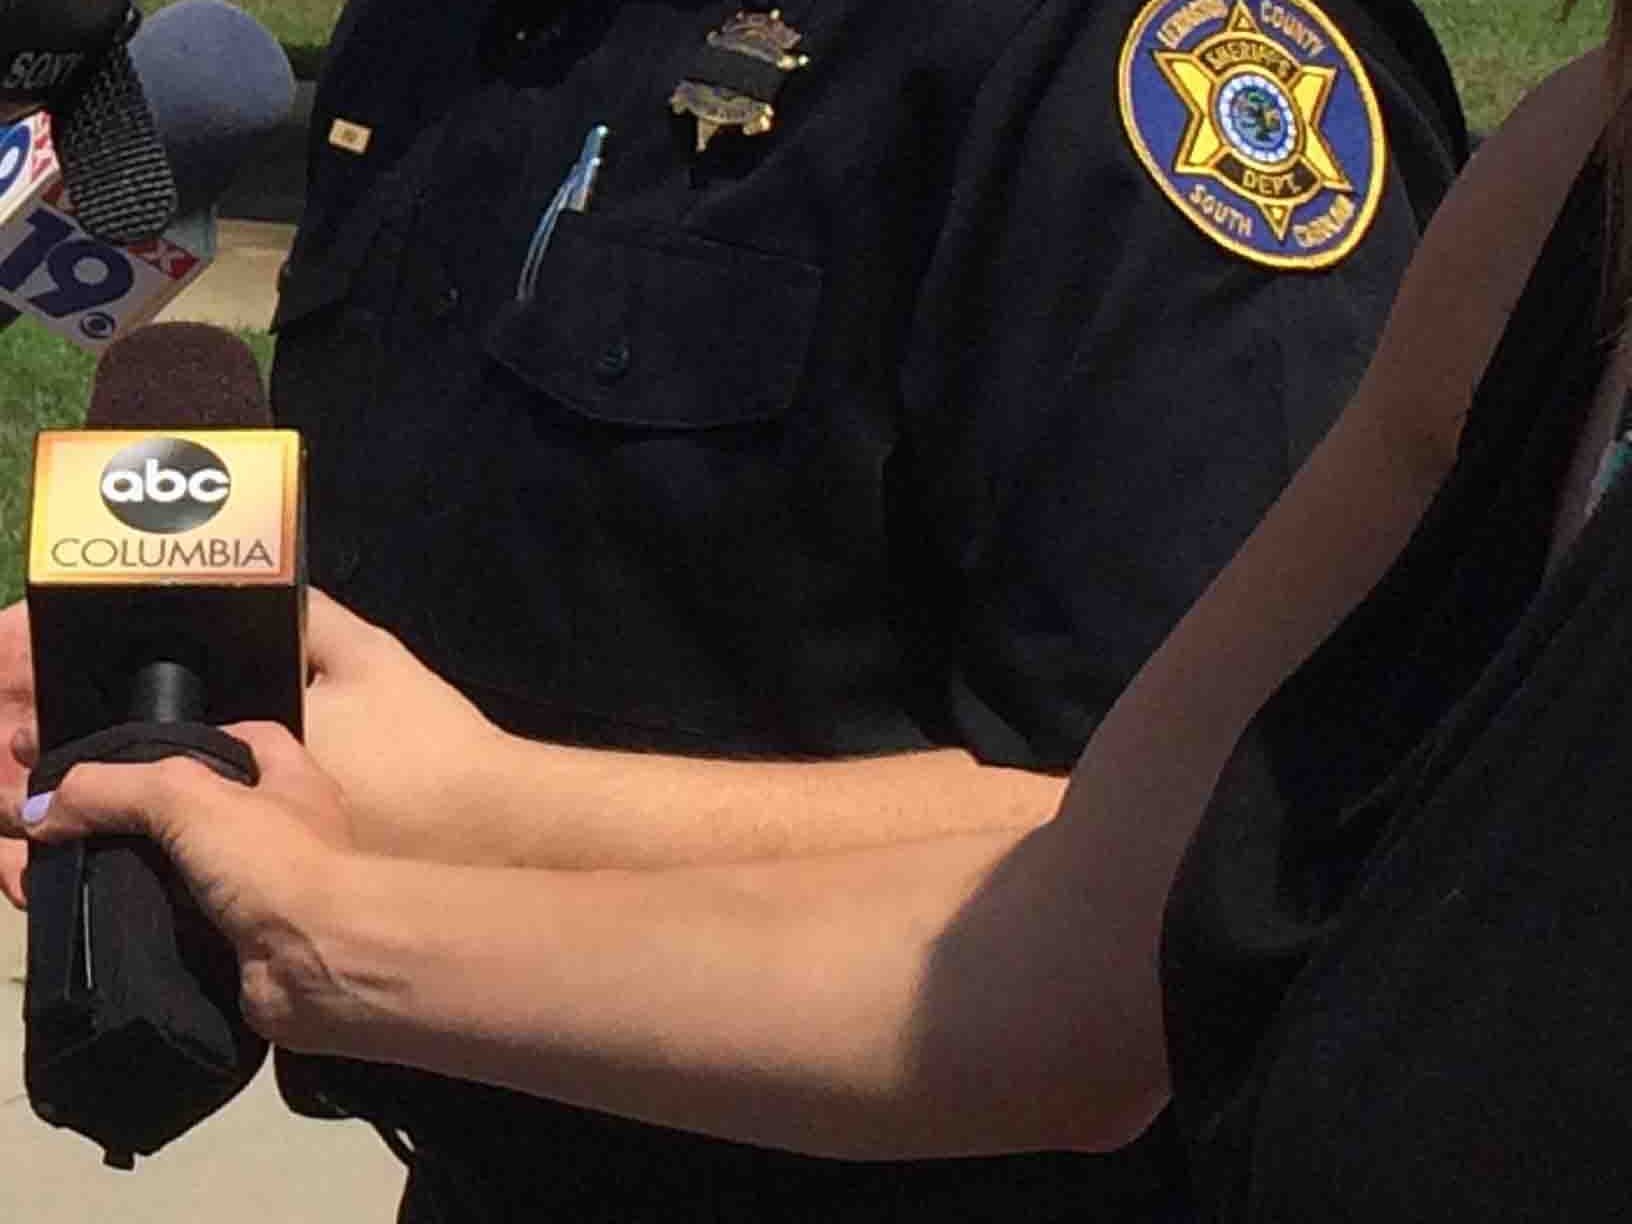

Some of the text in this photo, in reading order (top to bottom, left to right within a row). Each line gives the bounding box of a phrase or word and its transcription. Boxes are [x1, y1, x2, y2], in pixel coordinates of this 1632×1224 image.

[1189, 183, 1253, 237] SOUTH
[101, 457, 230, 503] abc
[50, 536, 274, 569] COLUMBIA
